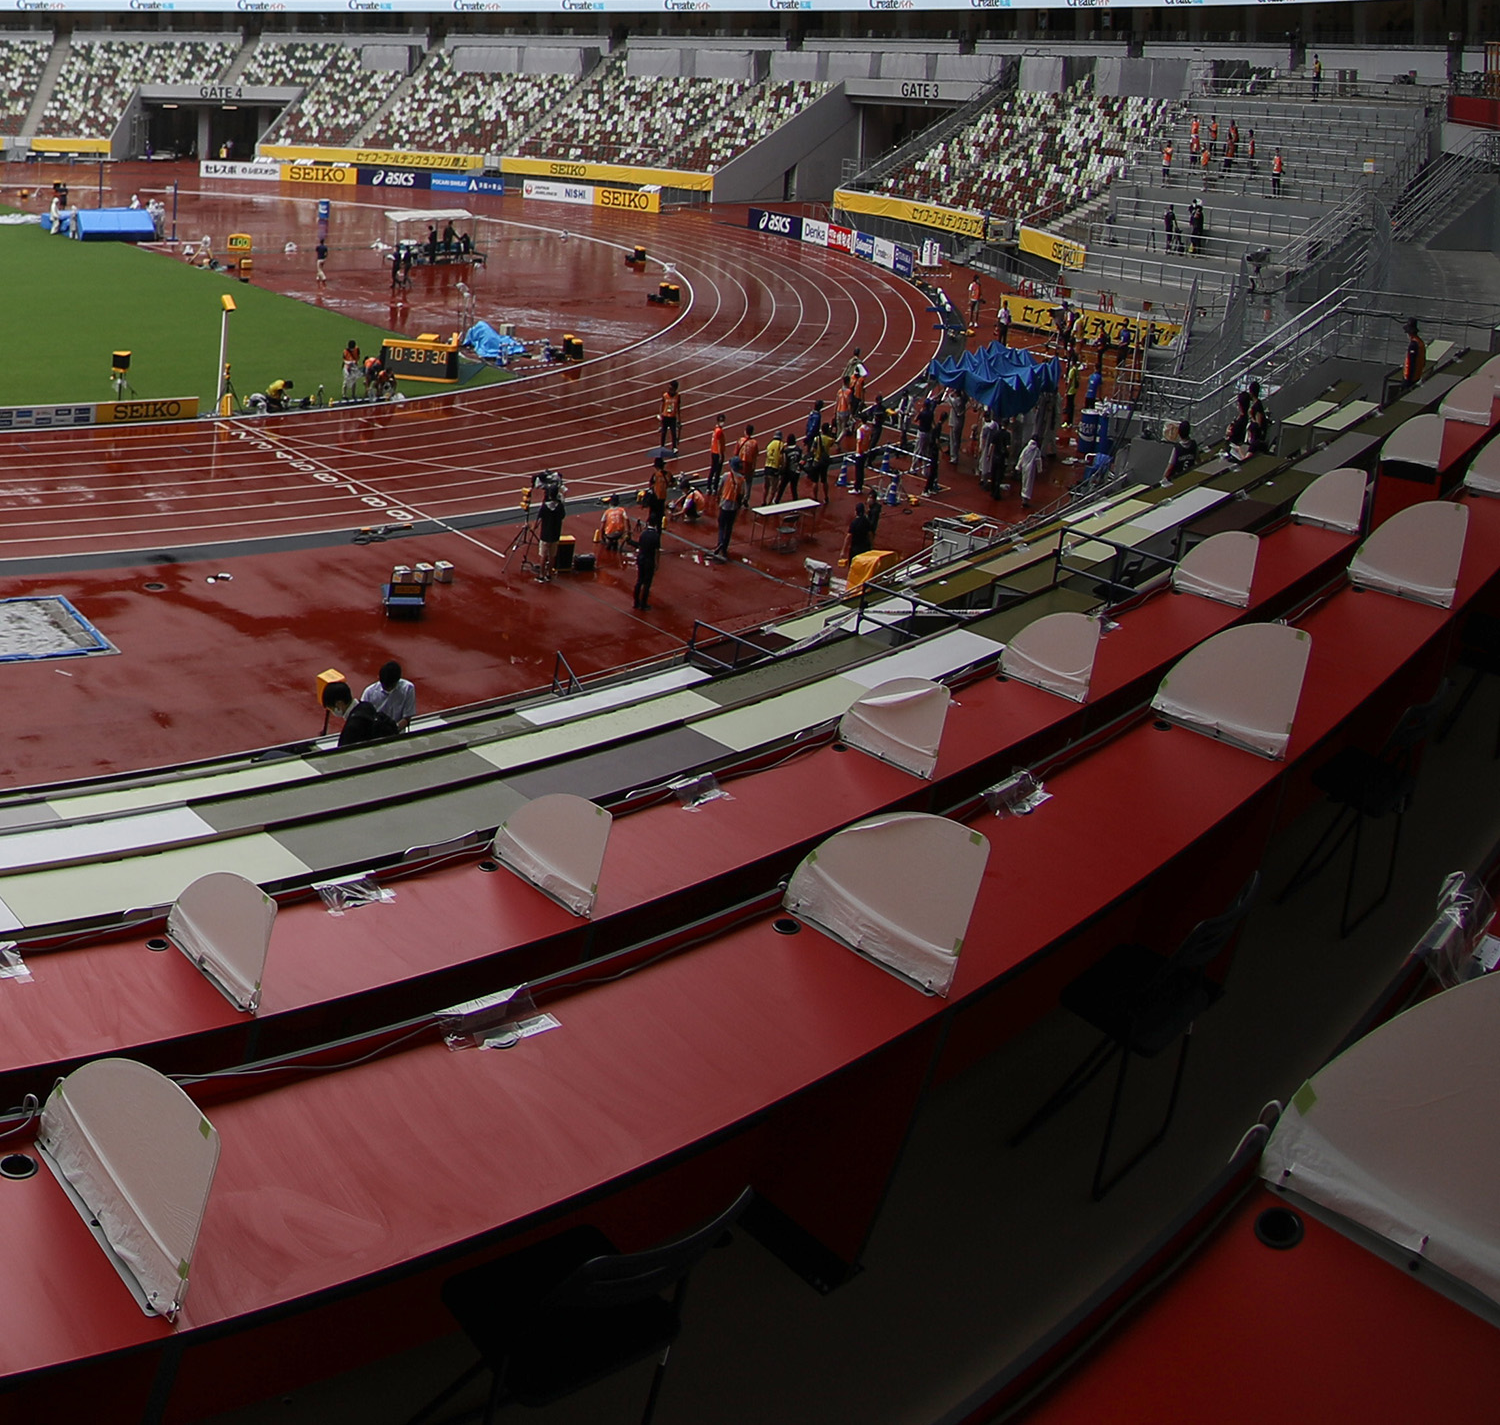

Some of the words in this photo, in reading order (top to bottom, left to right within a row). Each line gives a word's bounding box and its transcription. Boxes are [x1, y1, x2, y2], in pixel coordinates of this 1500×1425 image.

[200, 86, 232, 98] GATE
[235, 87, 243, 99] 4
[902, 82, 929, 98] GATE
[932, 83, 939, 98] 3
[289, 166, 346, 182] SEIKO
[550, 163, 587, 176] SEIKO
[564, 188, 586, 199] NISHI
[601, 189, 649, 210] SEIKO
[804, 223, 826, 241] Denka
[113, 402, 181, 420] SEIKO
[290, 460, 315, 471] 5
[334, 483, 358, 495] 7
[361, 496, 388, 508] 8
[386, 509, 414, 521] 9
